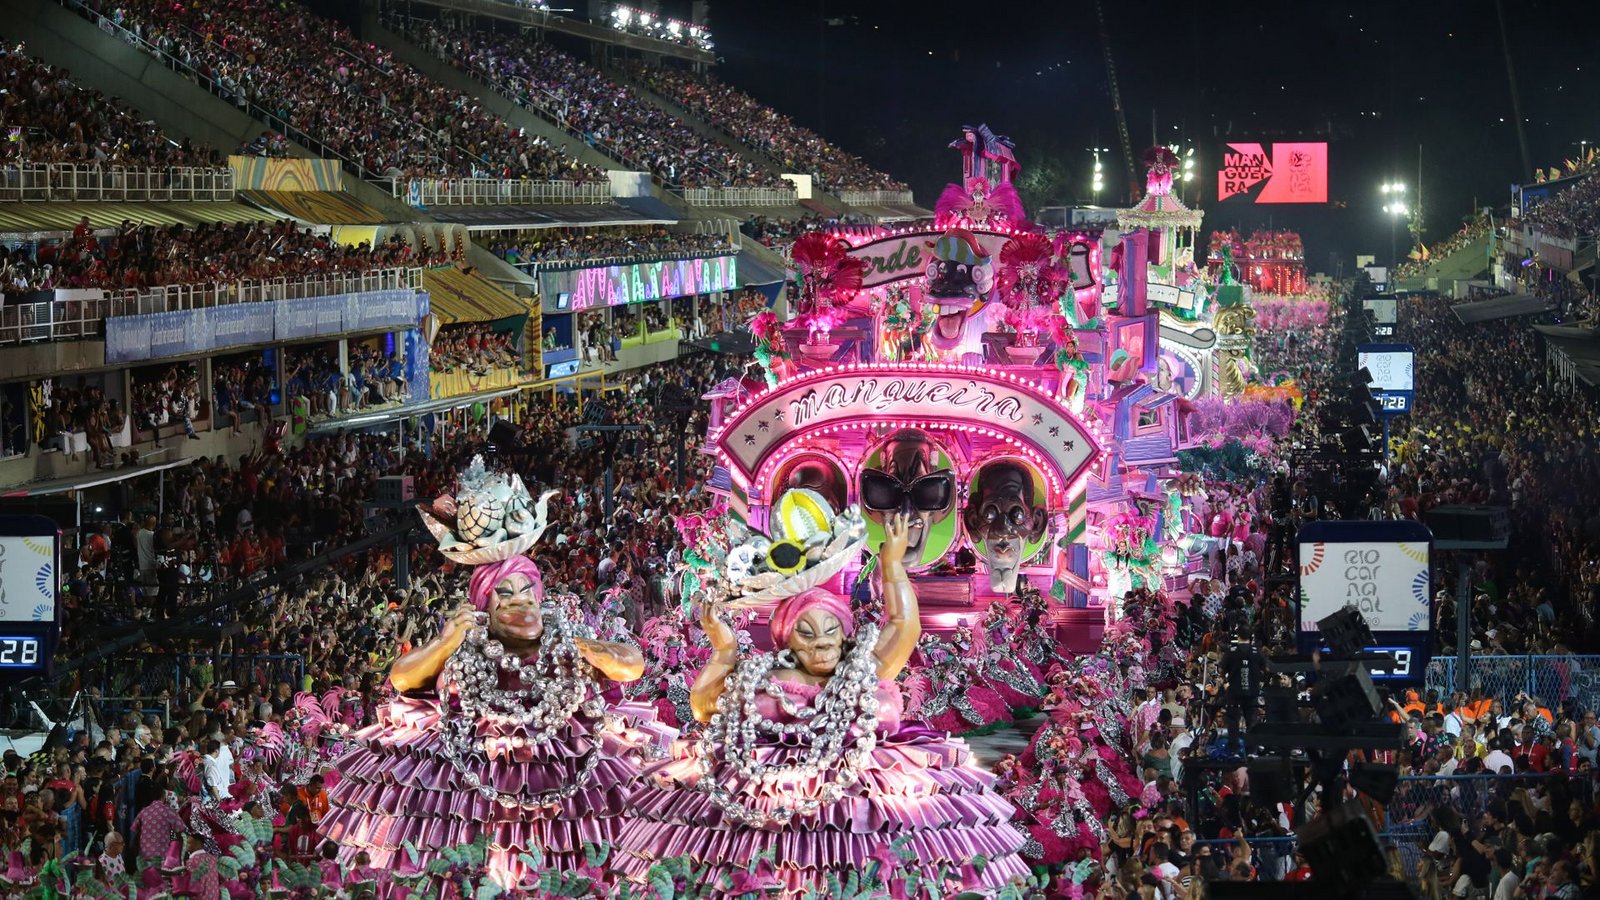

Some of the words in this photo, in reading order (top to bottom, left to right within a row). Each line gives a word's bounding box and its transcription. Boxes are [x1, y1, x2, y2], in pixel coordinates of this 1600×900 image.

[1224, 153, 1264, 167] MAN
[1224, 167, 1265, 180] GUEI
[1225, 181, 1249, 194] RA
[861, 240, 922, 278] erde
[1344, 565, 1382, 581] car
[1346, 582, 1378, 597] na
